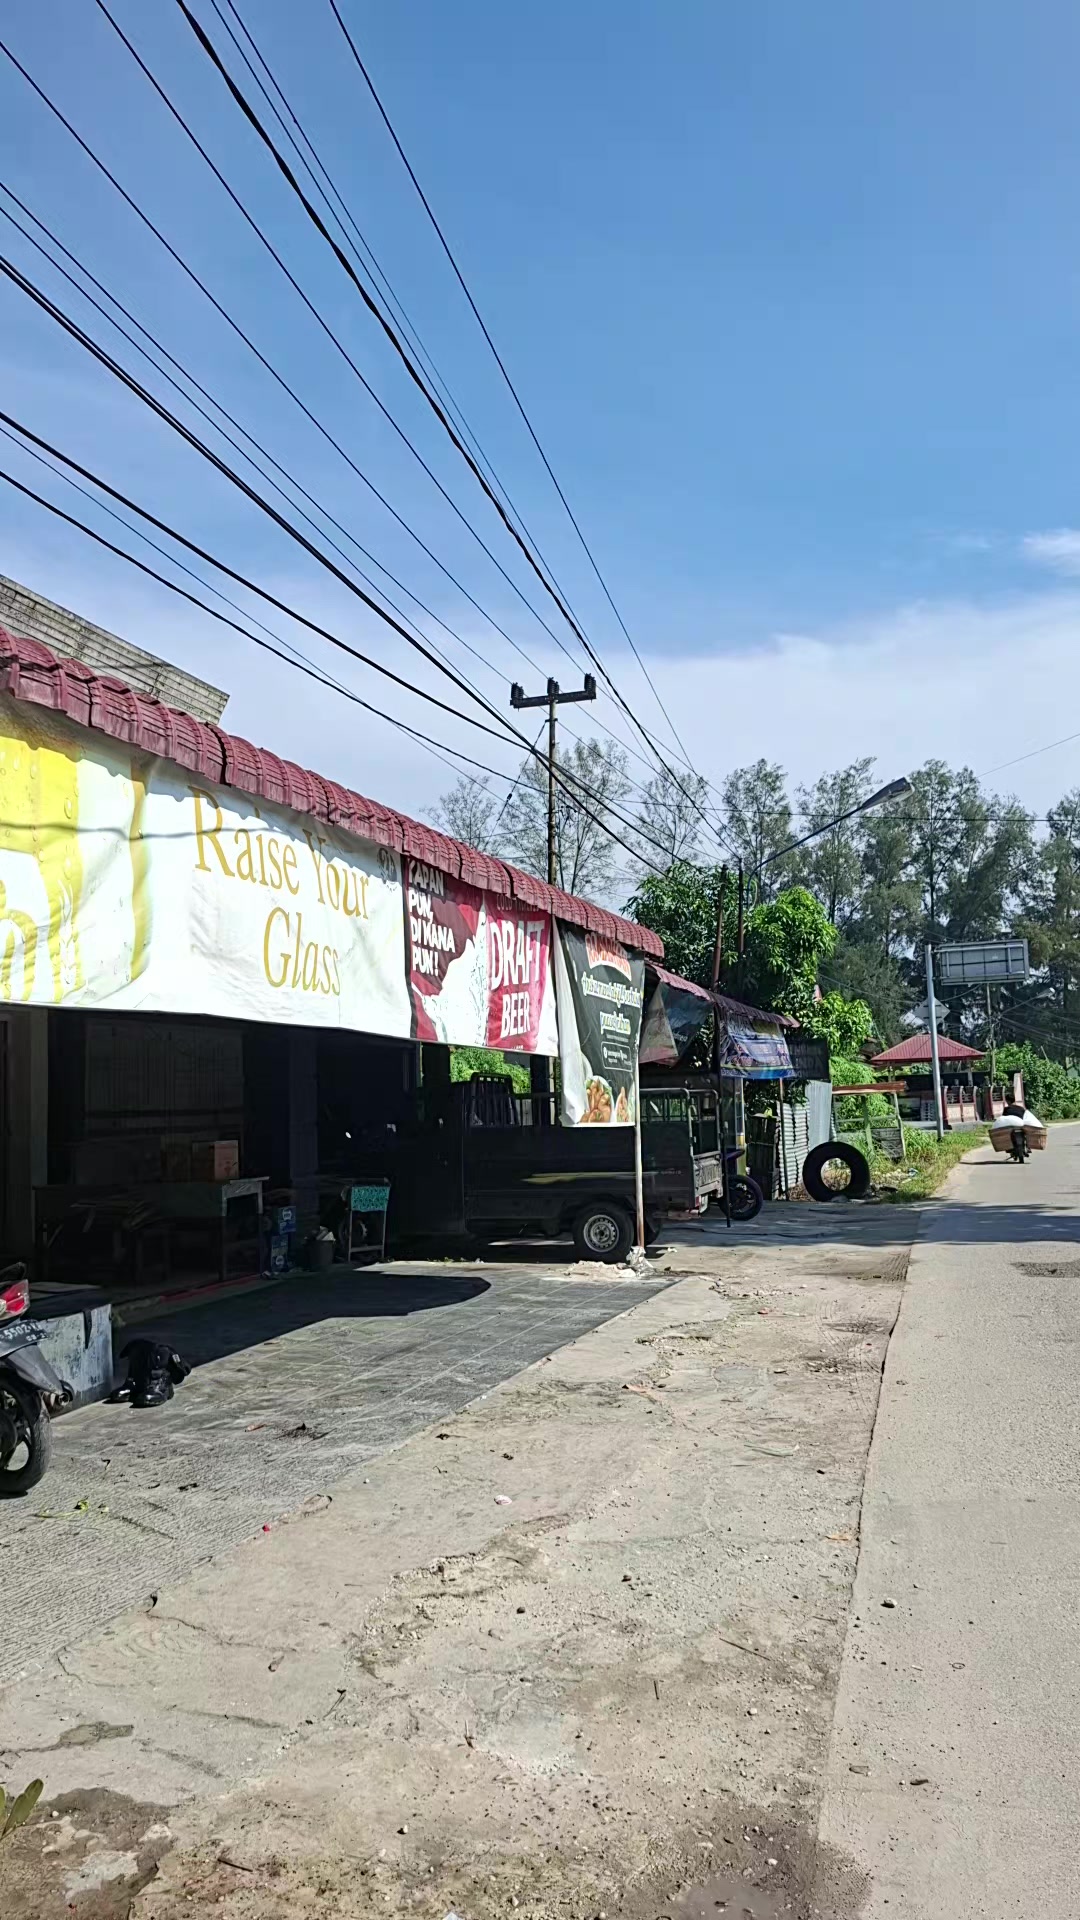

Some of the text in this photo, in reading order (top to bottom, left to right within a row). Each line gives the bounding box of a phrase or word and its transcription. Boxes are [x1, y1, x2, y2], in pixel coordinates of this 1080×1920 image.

[187, 785, 301, 896] Raise
[302, 828, 370, 921] Your
[263, 906, 341, 997] Glass
[489, 919, 546, 991] DRAFT
[500, 990, 531, 1039] BEER
